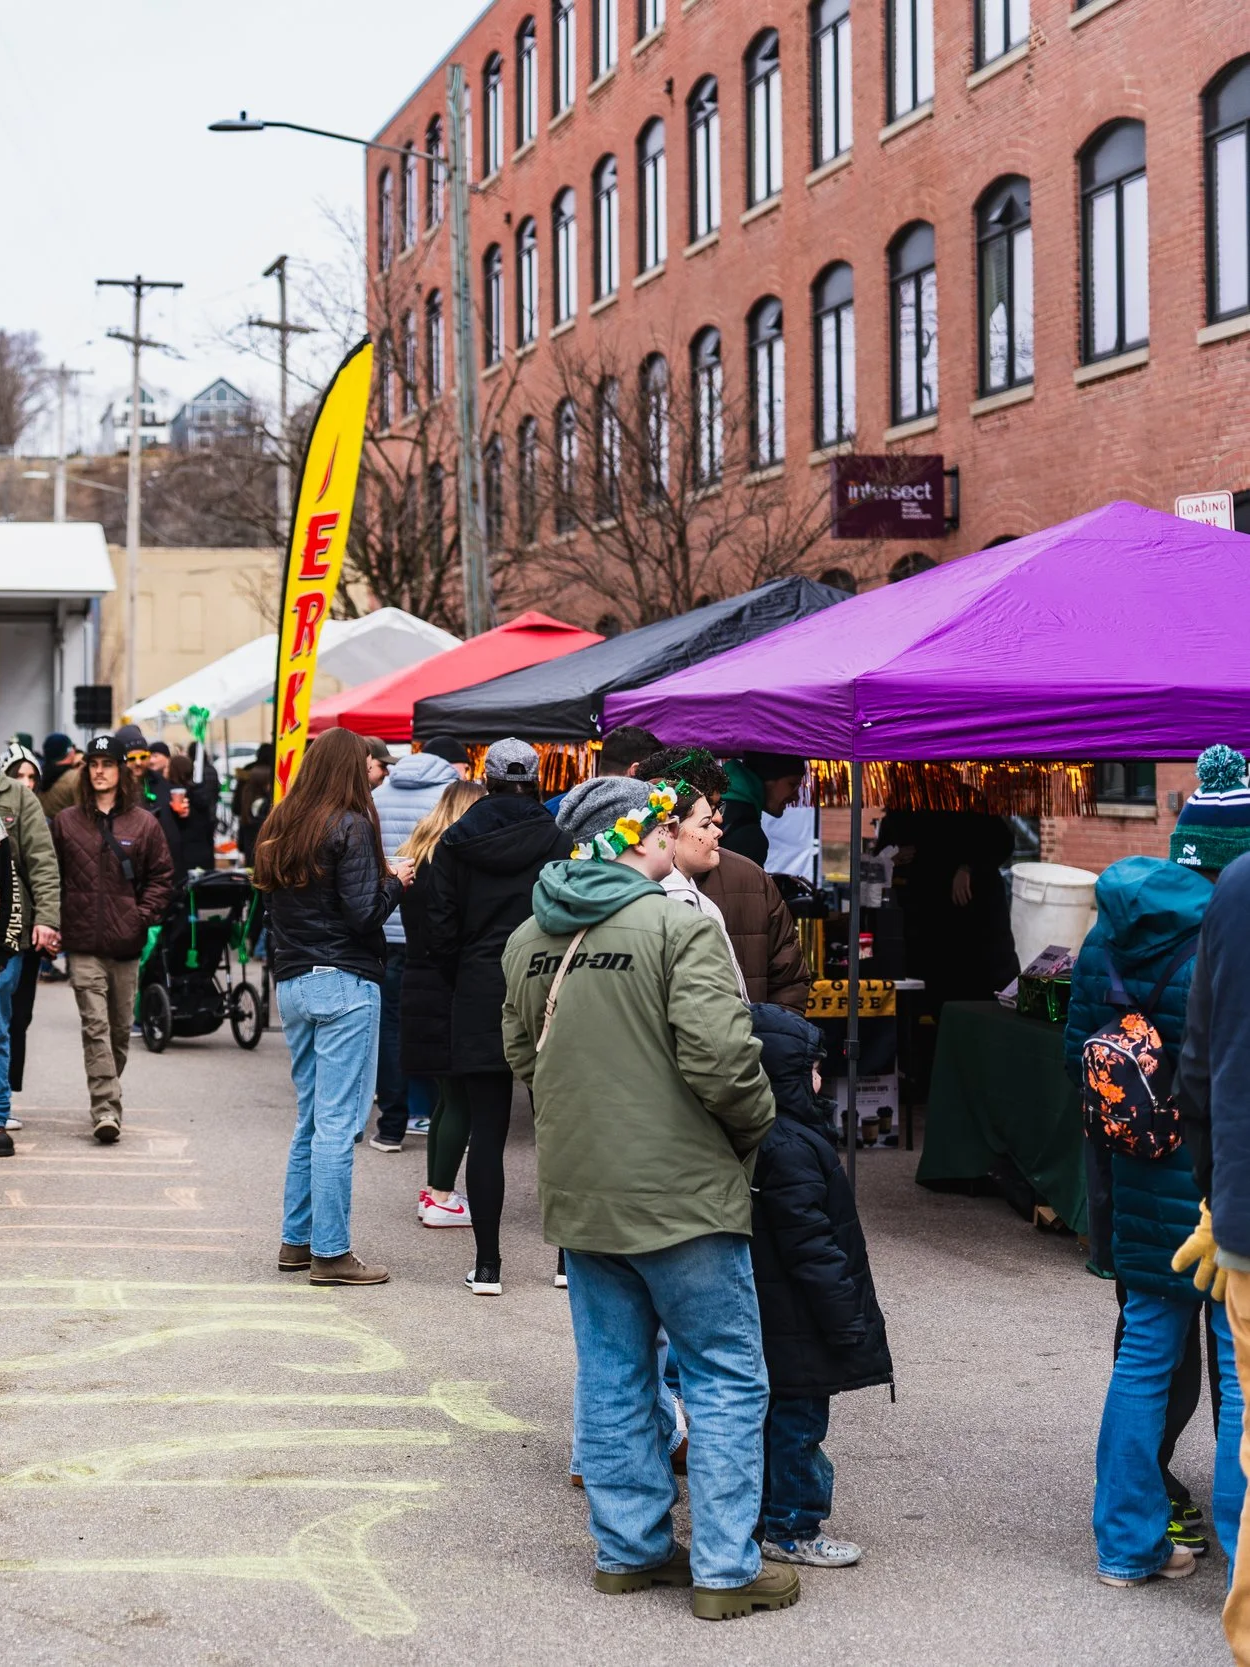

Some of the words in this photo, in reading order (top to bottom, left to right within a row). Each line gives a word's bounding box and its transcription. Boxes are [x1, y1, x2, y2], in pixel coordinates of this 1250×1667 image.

[1182, 500, 1226, 515] LOADING
[276, 433, 340, 799] ERKY
[831, 980, 895, 991] GLD
[806, 997, 881, 1009] OFFEE
